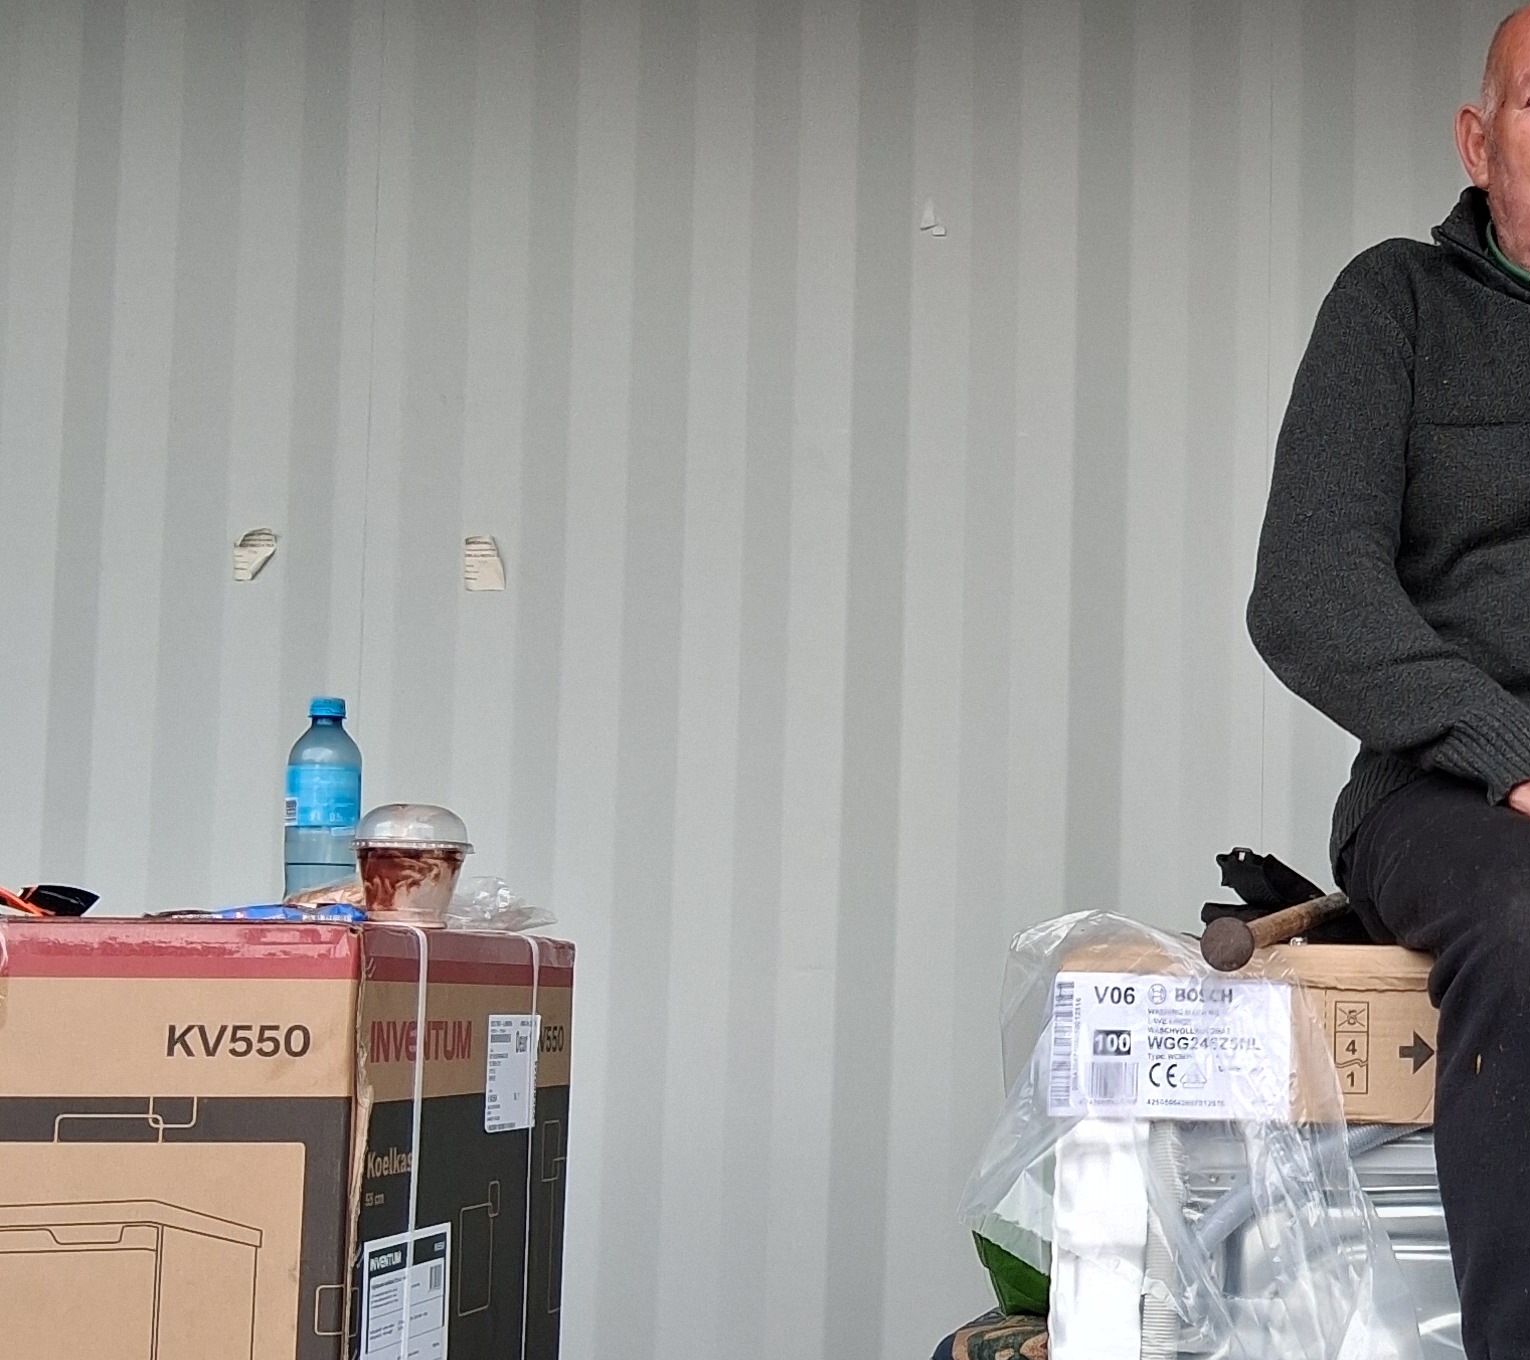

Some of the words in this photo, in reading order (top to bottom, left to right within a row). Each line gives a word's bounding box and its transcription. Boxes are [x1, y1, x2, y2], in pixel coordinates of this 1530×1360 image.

[1094, 985, 1136, 1005] V06
[1175, 987, 1233, 1003] BOSCH
[166, 1024, 312, 1058] KV550
[370, 1020, 473, 1064] INVENTUM
[539, 1025, 565, 1052] V550
[1095, 1034, 1131, 1052] 100
[1345, 1039, 1358, 1056] 4
[1148, 1061, 1178, 1088] CE
[1346, 1070, 1355, 1088] 1
[366, 1146, 413, 1179] Koelkas
